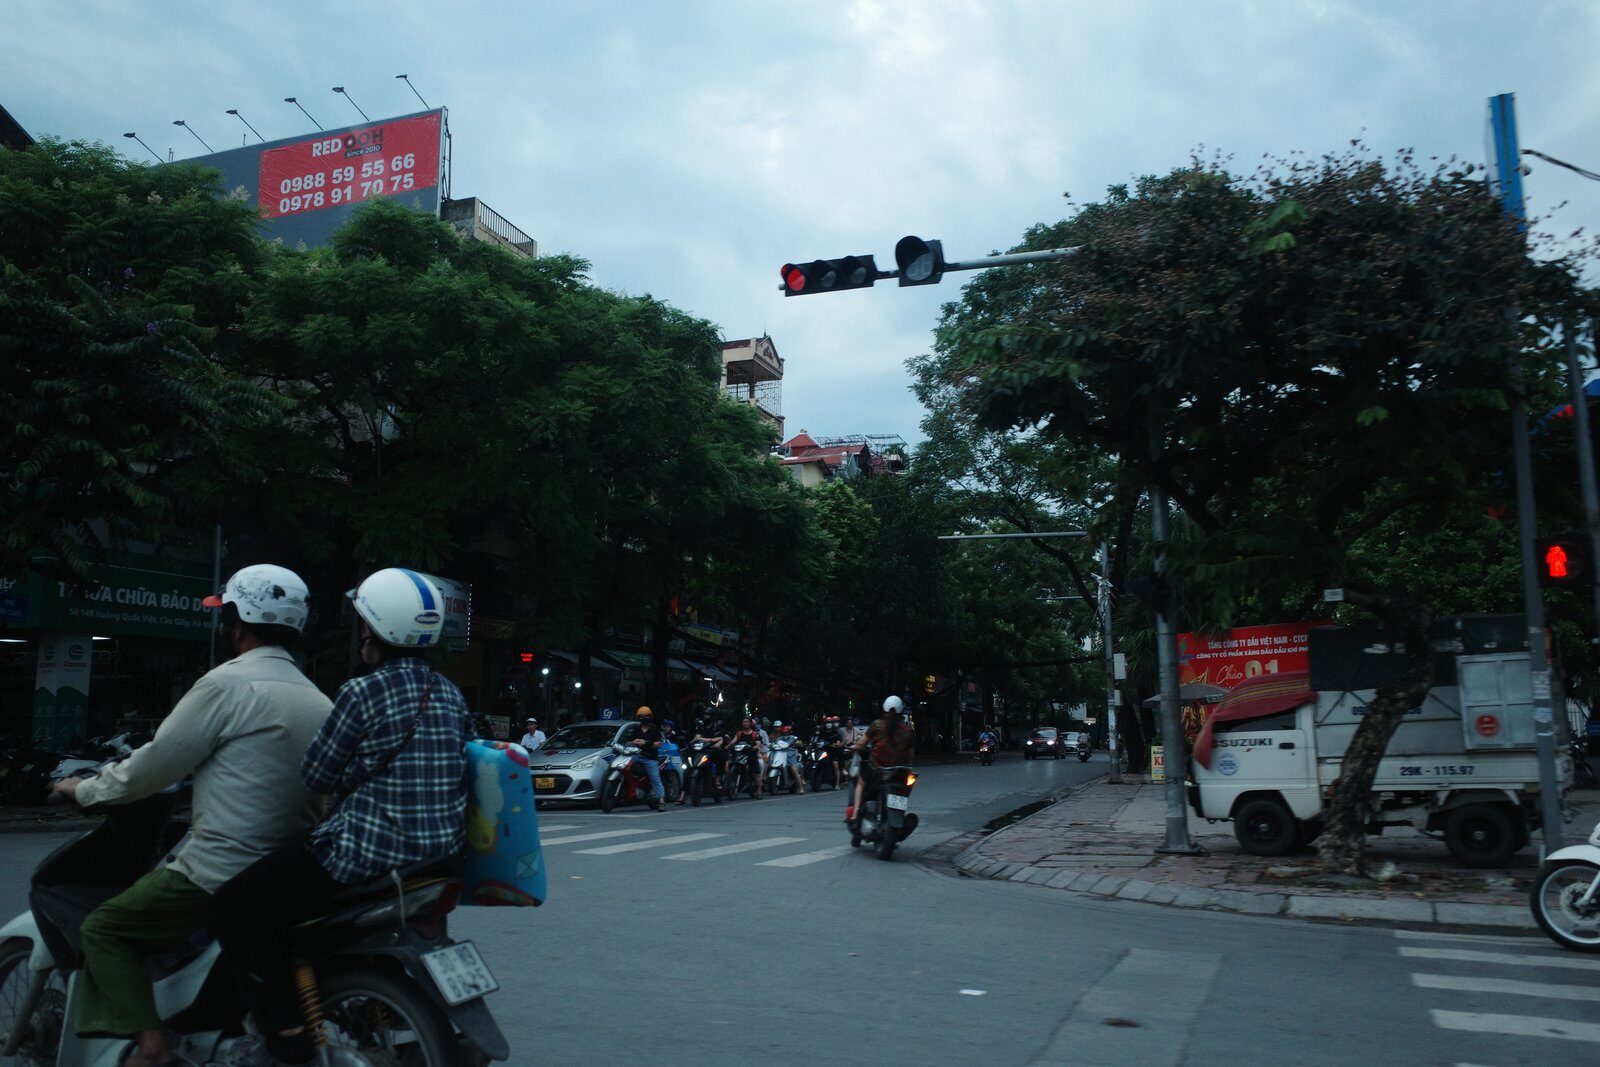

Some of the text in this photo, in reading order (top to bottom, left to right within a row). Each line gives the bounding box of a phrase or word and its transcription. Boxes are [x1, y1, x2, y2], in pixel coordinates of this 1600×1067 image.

[312, 128, 384, 157] RED OOH
[346, 144, 381, 158] since 2010
[280, 153, 415, 194] 0988 59 55 66
[279, 173, 414, 213] 0978 91 70 75
[116, 586, 157, 607] CHỮA
[161, 589, 190, 610] BẢO
[1239, 639, 1246, 648] TY
[1260, 635, 1272, 646] VIỆT
[1273, 636, 1288, 645] NAM
[1216, 663, 1243, 685] Chào
[1220, 738, 1272, 748] SUZUKI
[1434, 765, 1474, 776] 115.97
